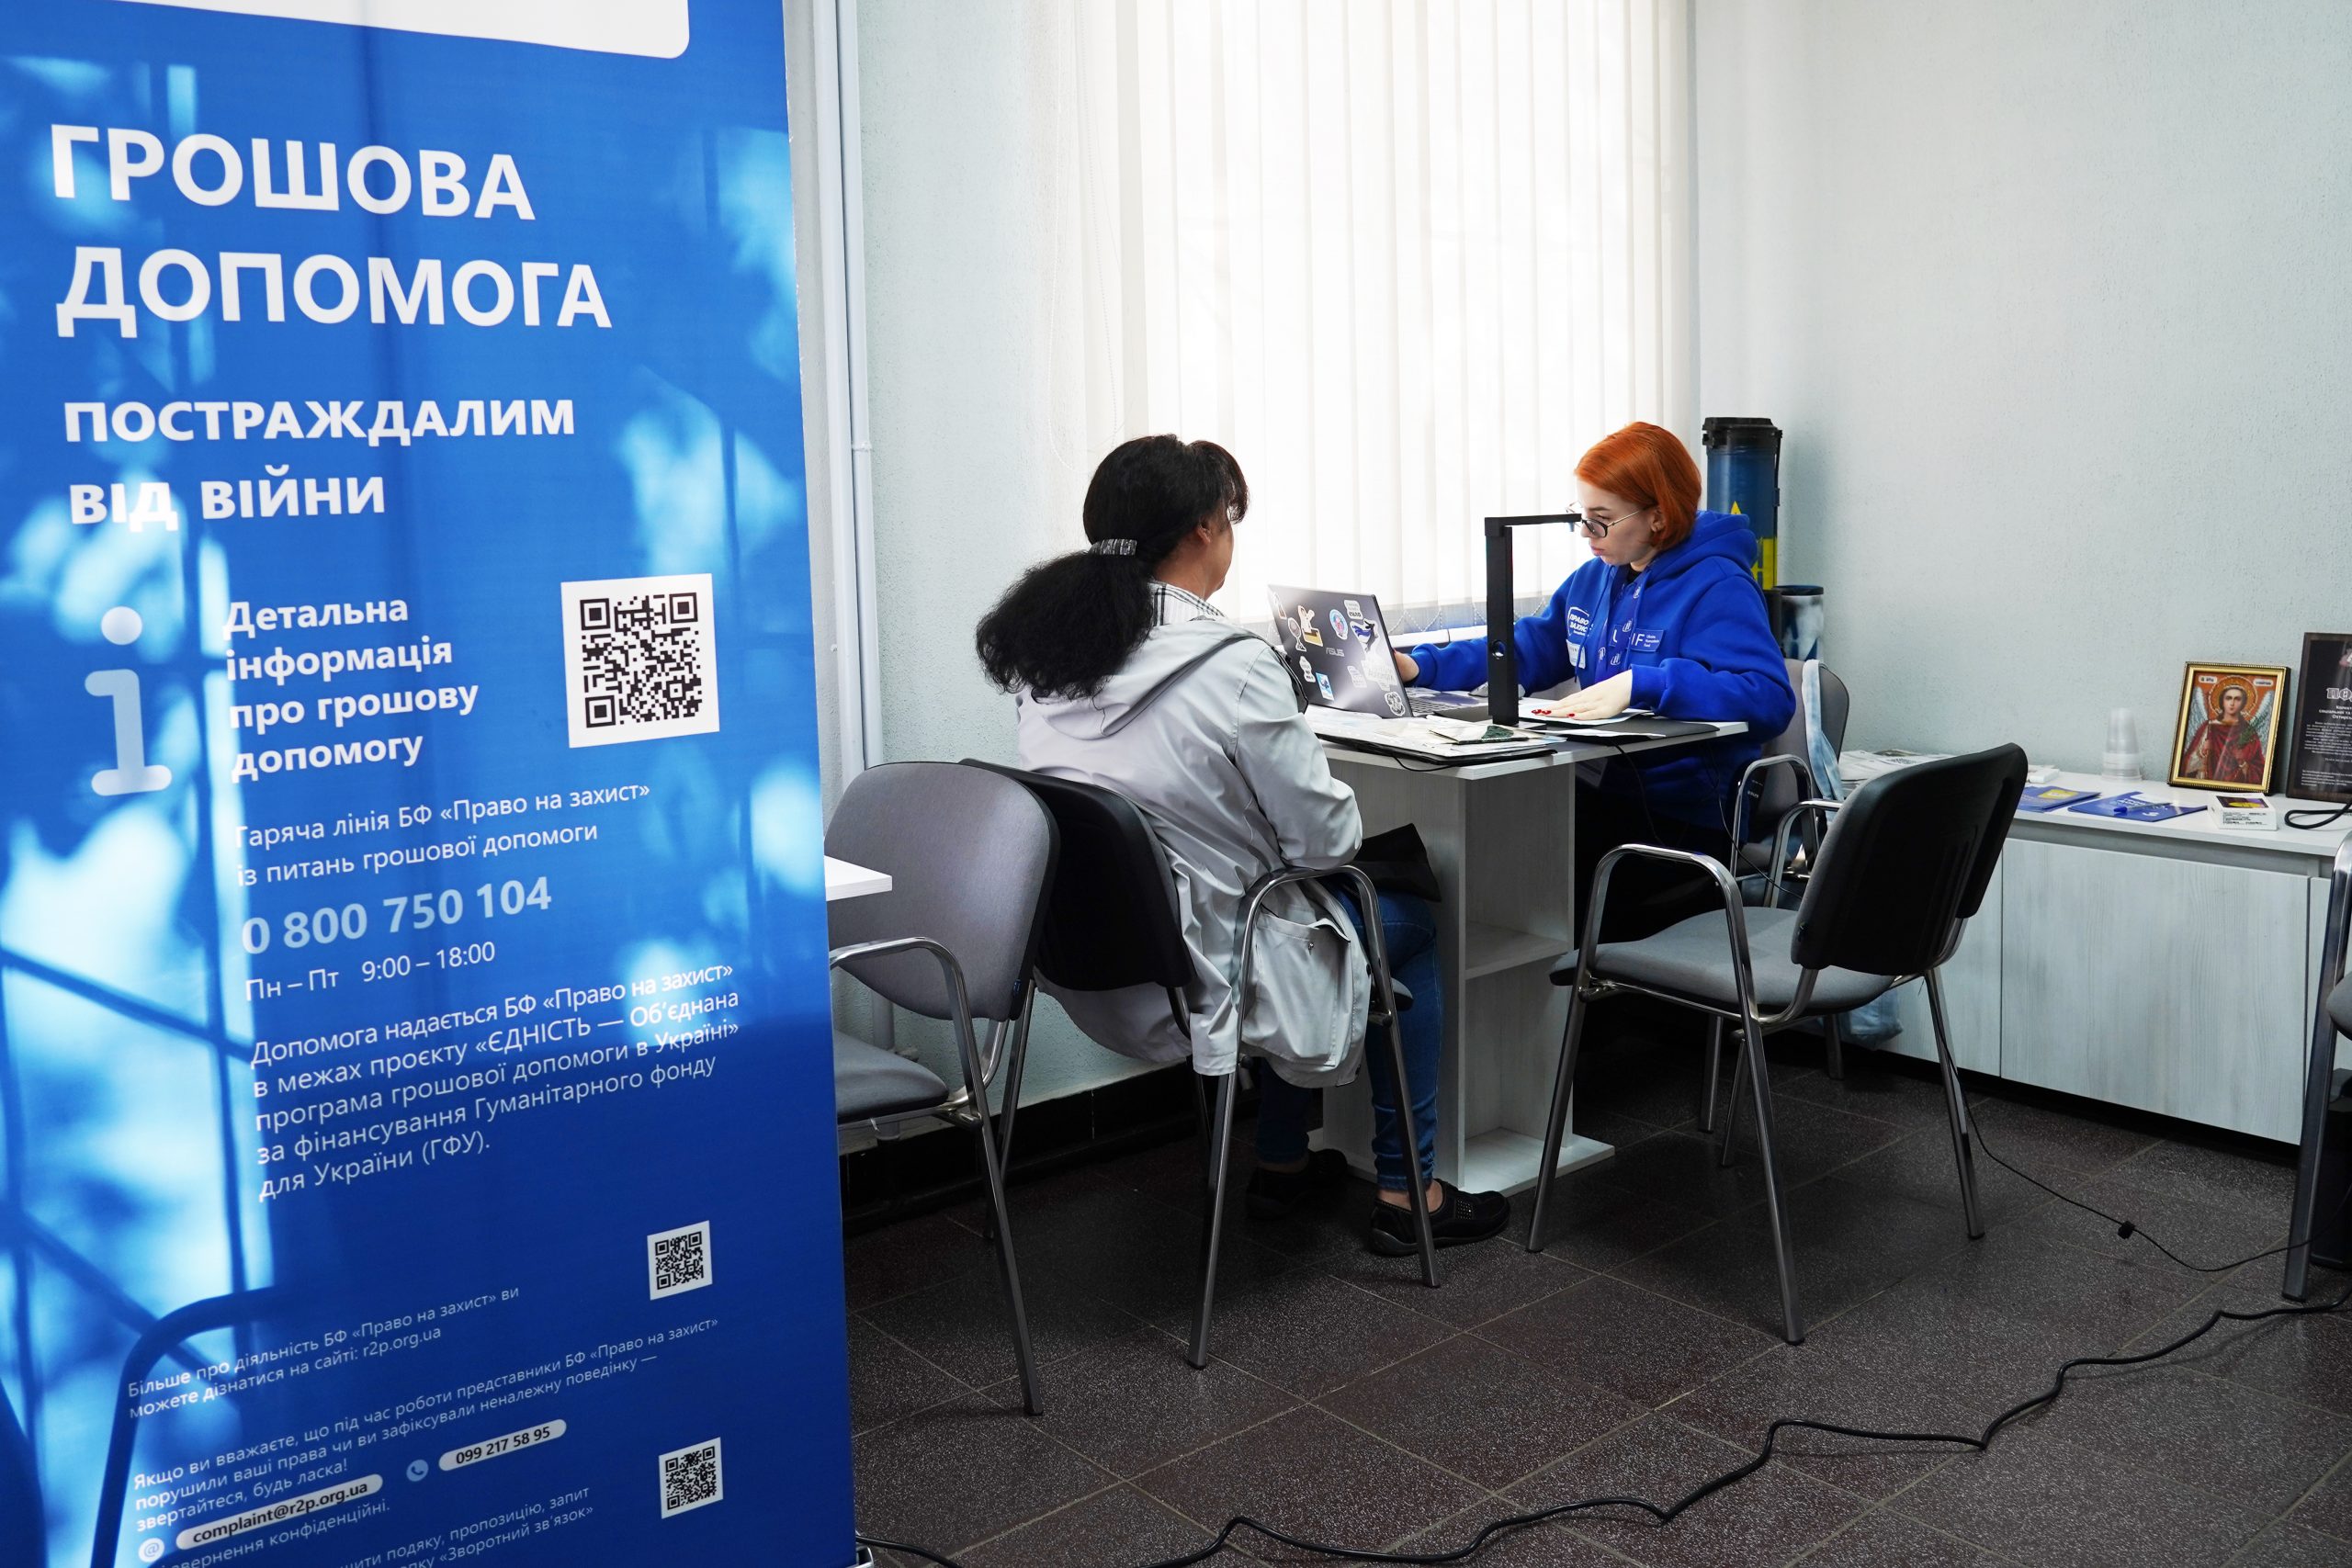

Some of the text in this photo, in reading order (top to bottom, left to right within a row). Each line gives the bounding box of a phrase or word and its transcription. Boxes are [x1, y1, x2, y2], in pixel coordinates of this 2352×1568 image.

[51, 124, 536, 220] ГРОШОВА
[56, 246, 612, 338] ДОПОМОГА
[64, 400, 575, 447] ПОСТРАЖДАЛИМ
[70, 465, 386, 531] ВІД ВІЙНИ
[222, 599, 408, 641] Детальна
[1326, 647, 1345, 657] ASUS
[227, 636, 453, 686] інформація
[230, 684, 479, 735] про грошову
[232, 736, 424, 784] допомогу
[235, 783, 650, 850] Гаряча лінія БФ «Право на захист»
[236, 825, 598, 886] із питань грошової допомоги
[242, 876, 551, 953] 0 800 750 104
[245, 978, 281, 1001] Пн
[309, 969, 339, 991] Пт
[361, 955, 410, 982] 9:00
[435, 942, 496, 968] 18:00
[250, 965, 733, 1070] Допомога надається БФ «Право на захист»
[254, 1080, 268, 1098] в
[277, 1063, 362, 1093] межах
[370, 1043, 468, 1078] проєкту
[475, 1017, 591, 1055] «ЄДНІСТЬ
[255, 1019, 739, 1134] програма грошової допомоги в Україні»
[257, 1056, 717, 1165] за фінансування Гуманітарного фонду
[259, 1131, 490, 1202] для України (ГФУ).
[128, 1287, 519, 1398] Більше про діяльність БФ «Право на захист» ви
[130, 1325, 441, 1419] можете дізнатися на сайті: r2p.org.ua
[133, 1318, 718, 1490] Якщо ви вважаєте, що під час роботи представники БФ «Право на захист»
[135, 1475, 228, 1511] порушили
[233, 1459, 272, 1482] ваші
[277, 1446, 327, 1471] права
[332, 1438, 353, 1452] чи
[357, 1431, 377, 1448] ви
[381, 1403, 475, 1440] зафіксували
[480, 1378, 560, 1412] неналежну
[566, 1356, 638, 1386] поведінку
[456, 1426, 550, 1465] 099 217 58 95
[136, 1458, 348, 1532] звертайтеся, будь ласка!
[193, 1482, 368, 1543] complaint@r2p.org.ua
[269, 1498, 390, 1546] конфіденційні.
[387, 1536, 445, 1562] подяку,
[450, 1501, 546, 1542] пропозицію,
[550, 1487, 590, 1509] запит
[439, 1523, 530, 1563] «Зворотний
